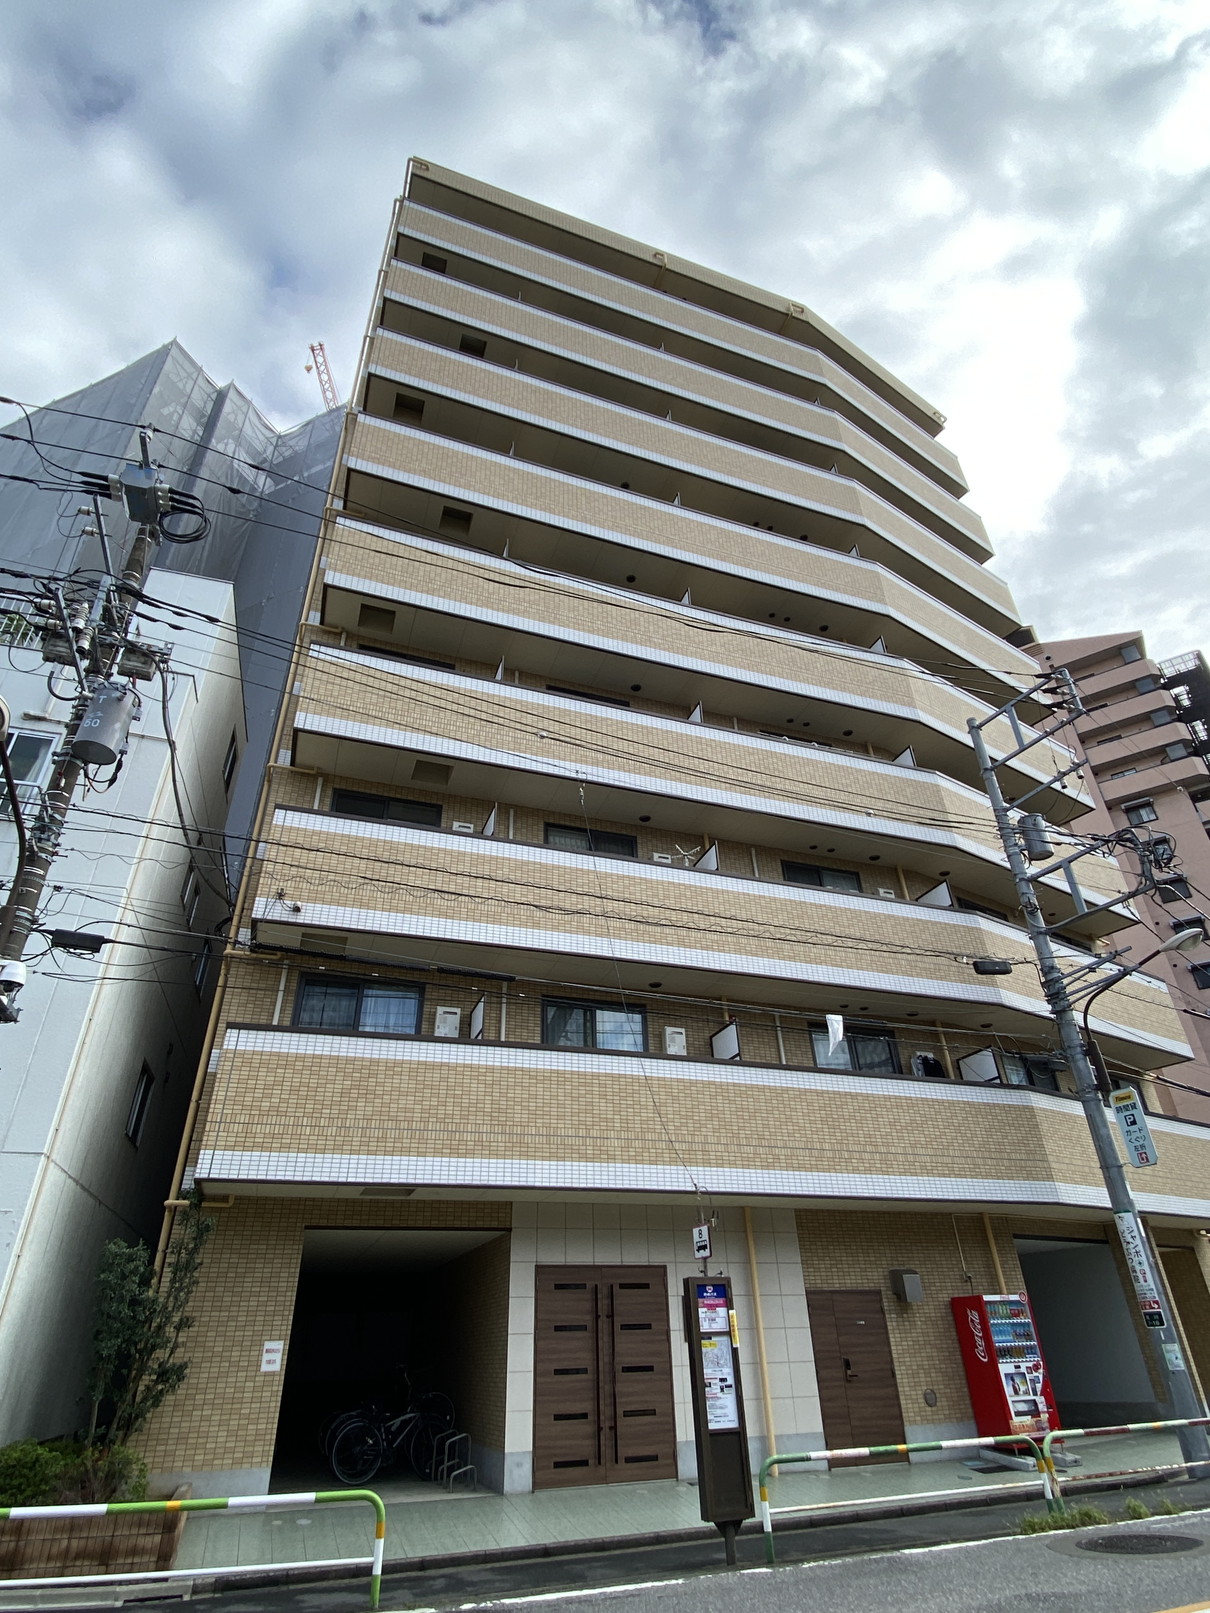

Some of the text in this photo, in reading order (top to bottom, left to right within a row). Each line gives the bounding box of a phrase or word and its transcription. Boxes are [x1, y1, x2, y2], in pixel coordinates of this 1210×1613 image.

[1126, 1115, 1135, 1126] P
[1125, 1127, 1144, 1136] ガード
[698, 1229, 703, 1239] 8
